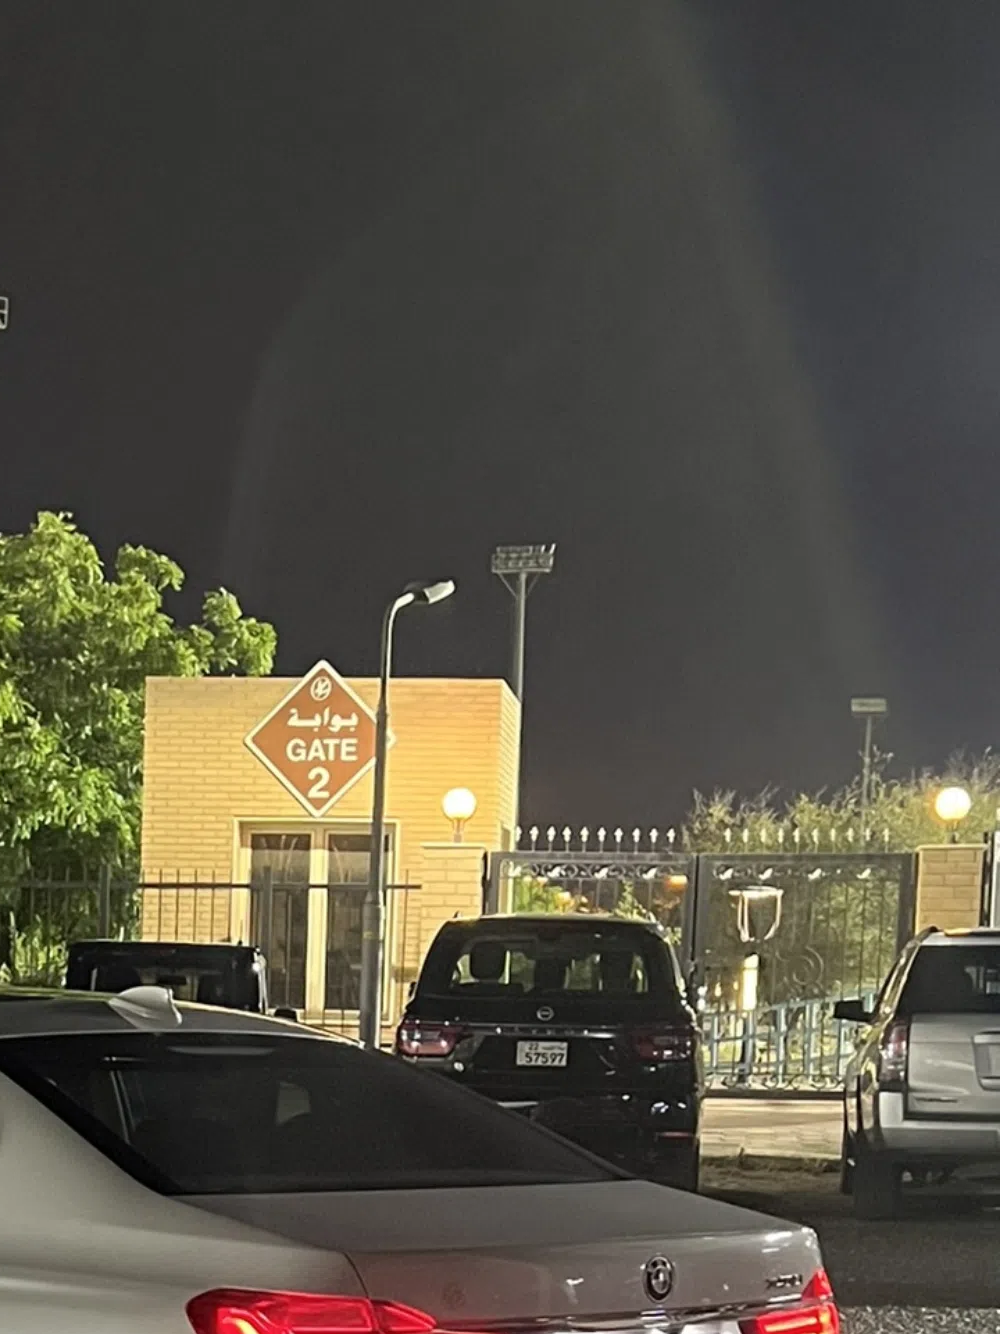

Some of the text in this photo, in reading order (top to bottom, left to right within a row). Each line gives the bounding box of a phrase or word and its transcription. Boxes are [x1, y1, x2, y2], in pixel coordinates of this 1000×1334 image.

[286, 706, 359, 732] بوابة
[286, 738, 358, 762] GATE
[307, 766, 331, 799] 2
[524, 1052, 565, 1065] 57597
